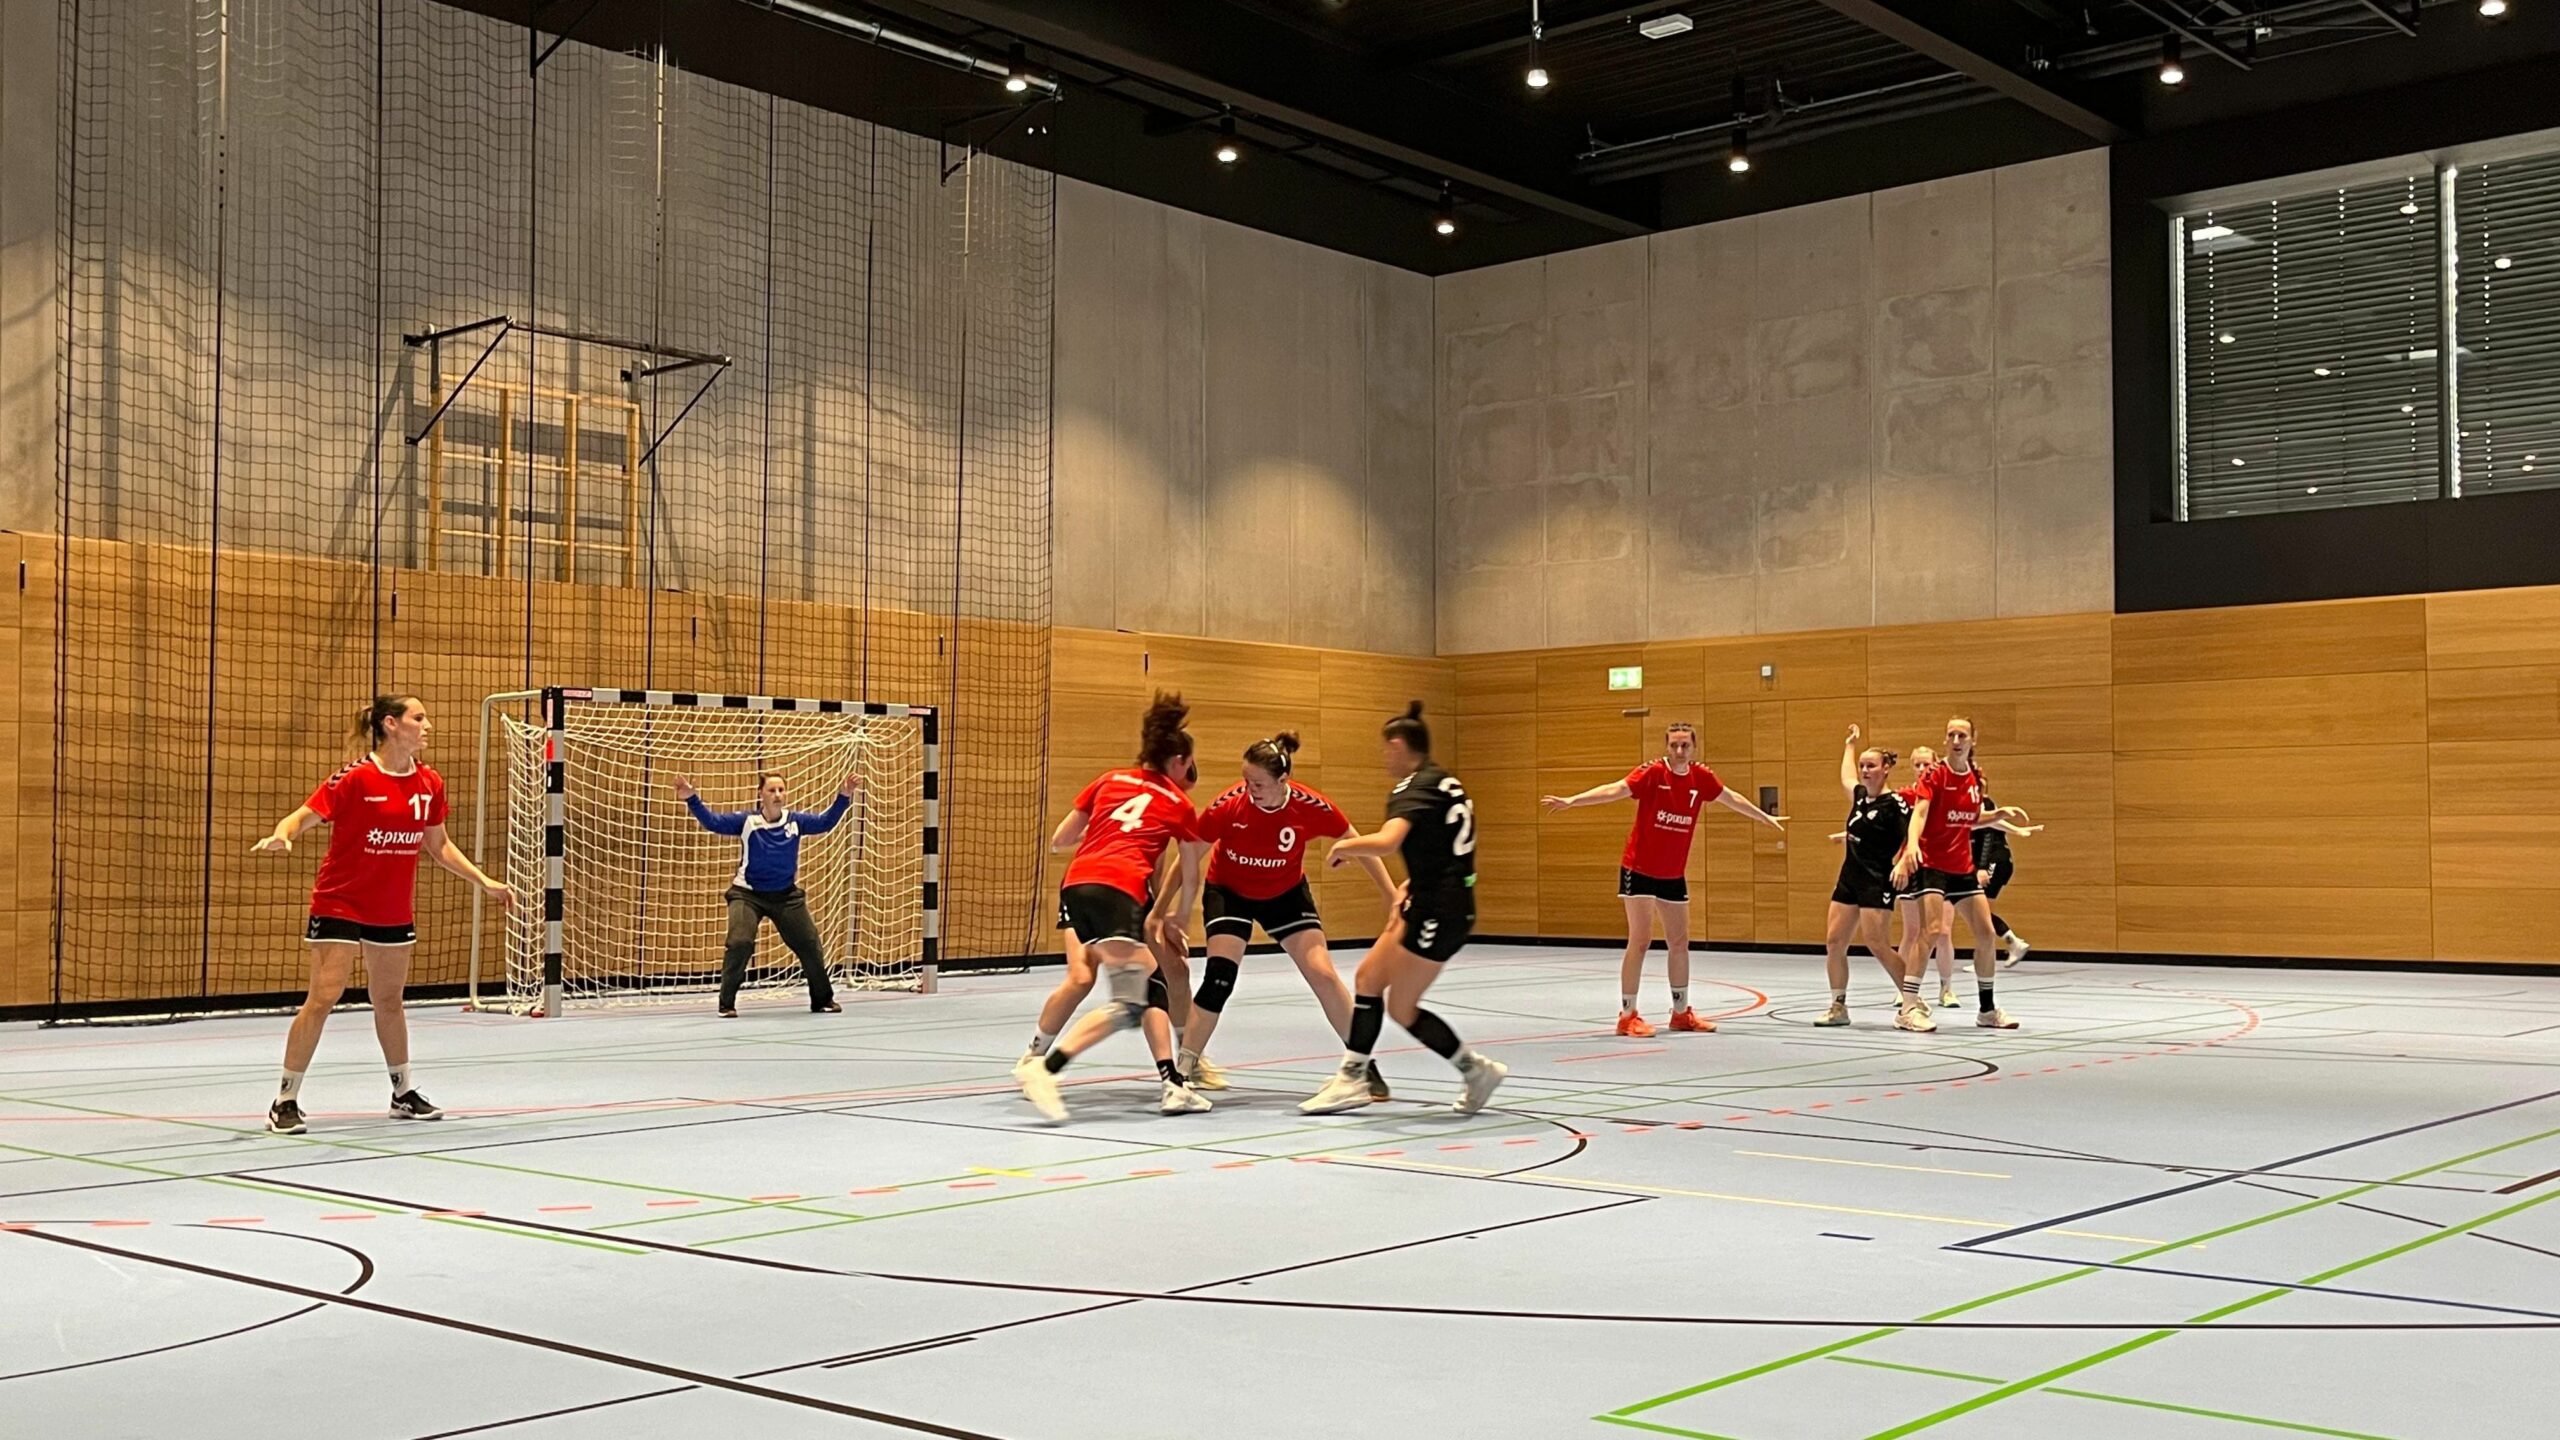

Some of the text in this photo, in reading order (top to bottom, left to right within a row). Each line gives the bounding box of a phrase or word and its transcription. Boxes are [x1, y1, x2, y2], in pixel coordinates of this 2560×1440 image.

[408, 793, 433, 821] 17
[1689, 789, 1698, 808] 7
[1110, 792, 1153, 833] 4
[1278, 827, 1296, 852] 9
